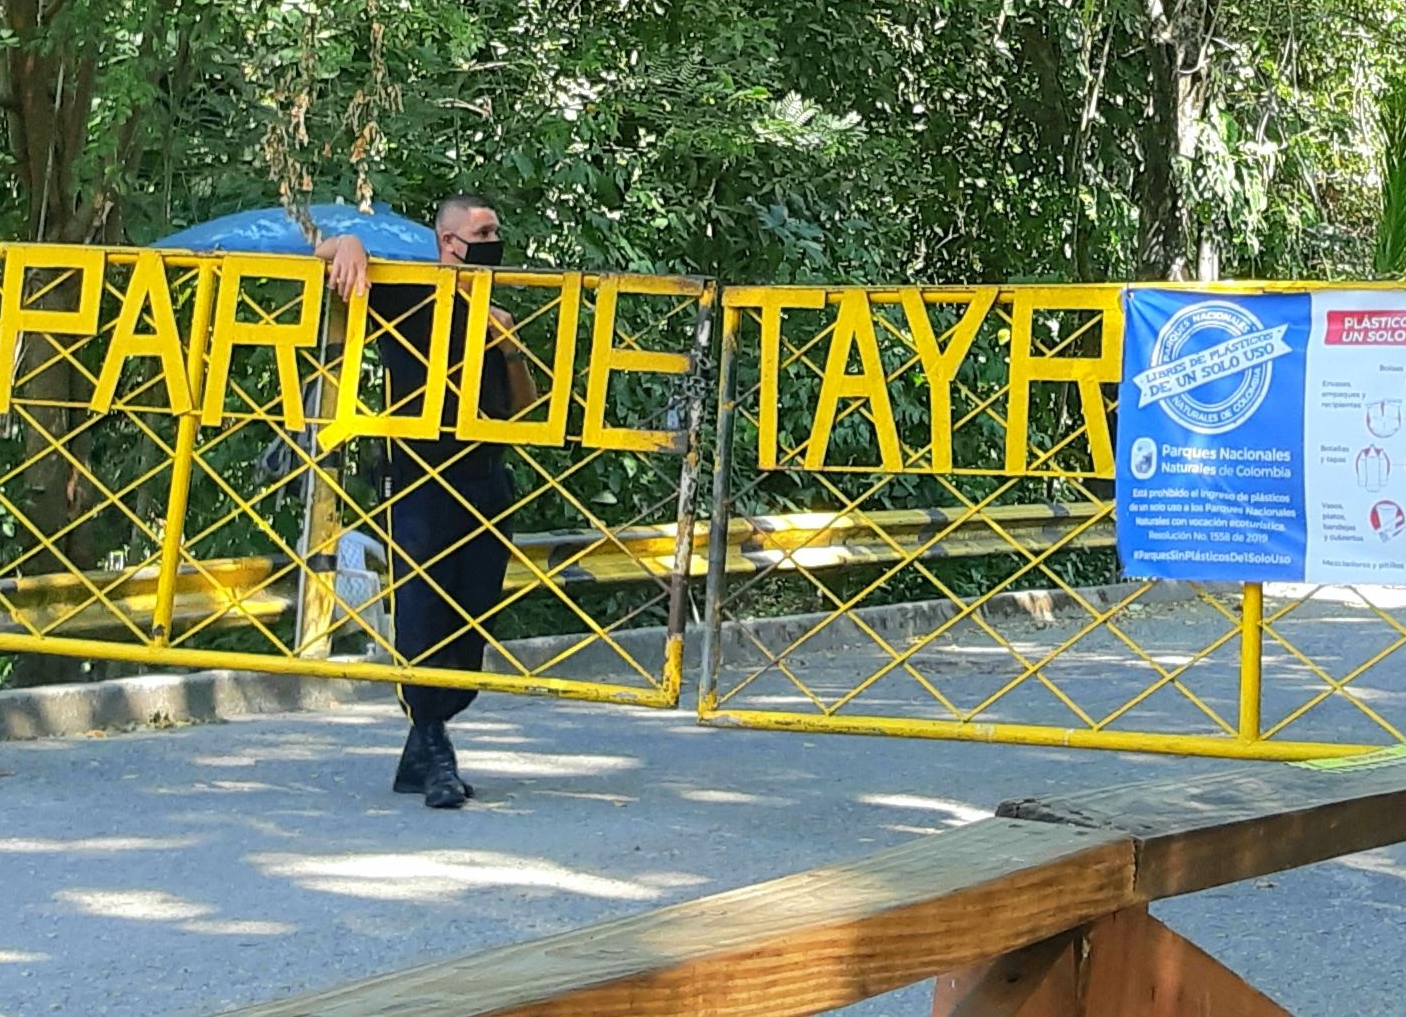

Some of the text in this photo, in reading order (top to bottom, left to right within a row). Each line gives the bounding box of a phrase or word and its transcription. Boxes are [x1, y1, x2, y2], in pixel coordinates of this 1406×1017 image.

[1164, 311, 1251, 362] PARQUES NACIONALES
[1342, 330, 1365, 343] UN
[1145, 363, 1187, 385] LIBRES
[1189, 354, 1207, 368] DE
[1148, 342, 1276, 398] DE UN SOLO USO
[1172, 396, 1219, 423] NATURALES
[1162, 445, 1291, 463] Parques Nacionales
[1161, 463, 1292, 478] Naturales de Colombia
[1149, 487, 1189, 500] prohibido
[1201, 488, 1235, 502] ingreso
[1237, 490, 1249, 501] de
[1250, 491, 1291, 504] plásticos
[1129, 503, 1139, 512] de
[1139, 504, 1149, 513] un
[1167, 504, 1182, 513] uso
[1191, 503, 1204, 513] los
[1205, 503, 1244, 516] Parques
[1245, 506, 1296, 518] Nacionales
[1135, 516, 1170, 526] Naturales
[1171, 518, 1187, 526] con
[1189, 516, 1227, 528] vocación
[1148, 530, 1192, 541] Resolución
[1232, 533, 1244, 543] de
[1245, 534, 1269, 544] 2019
